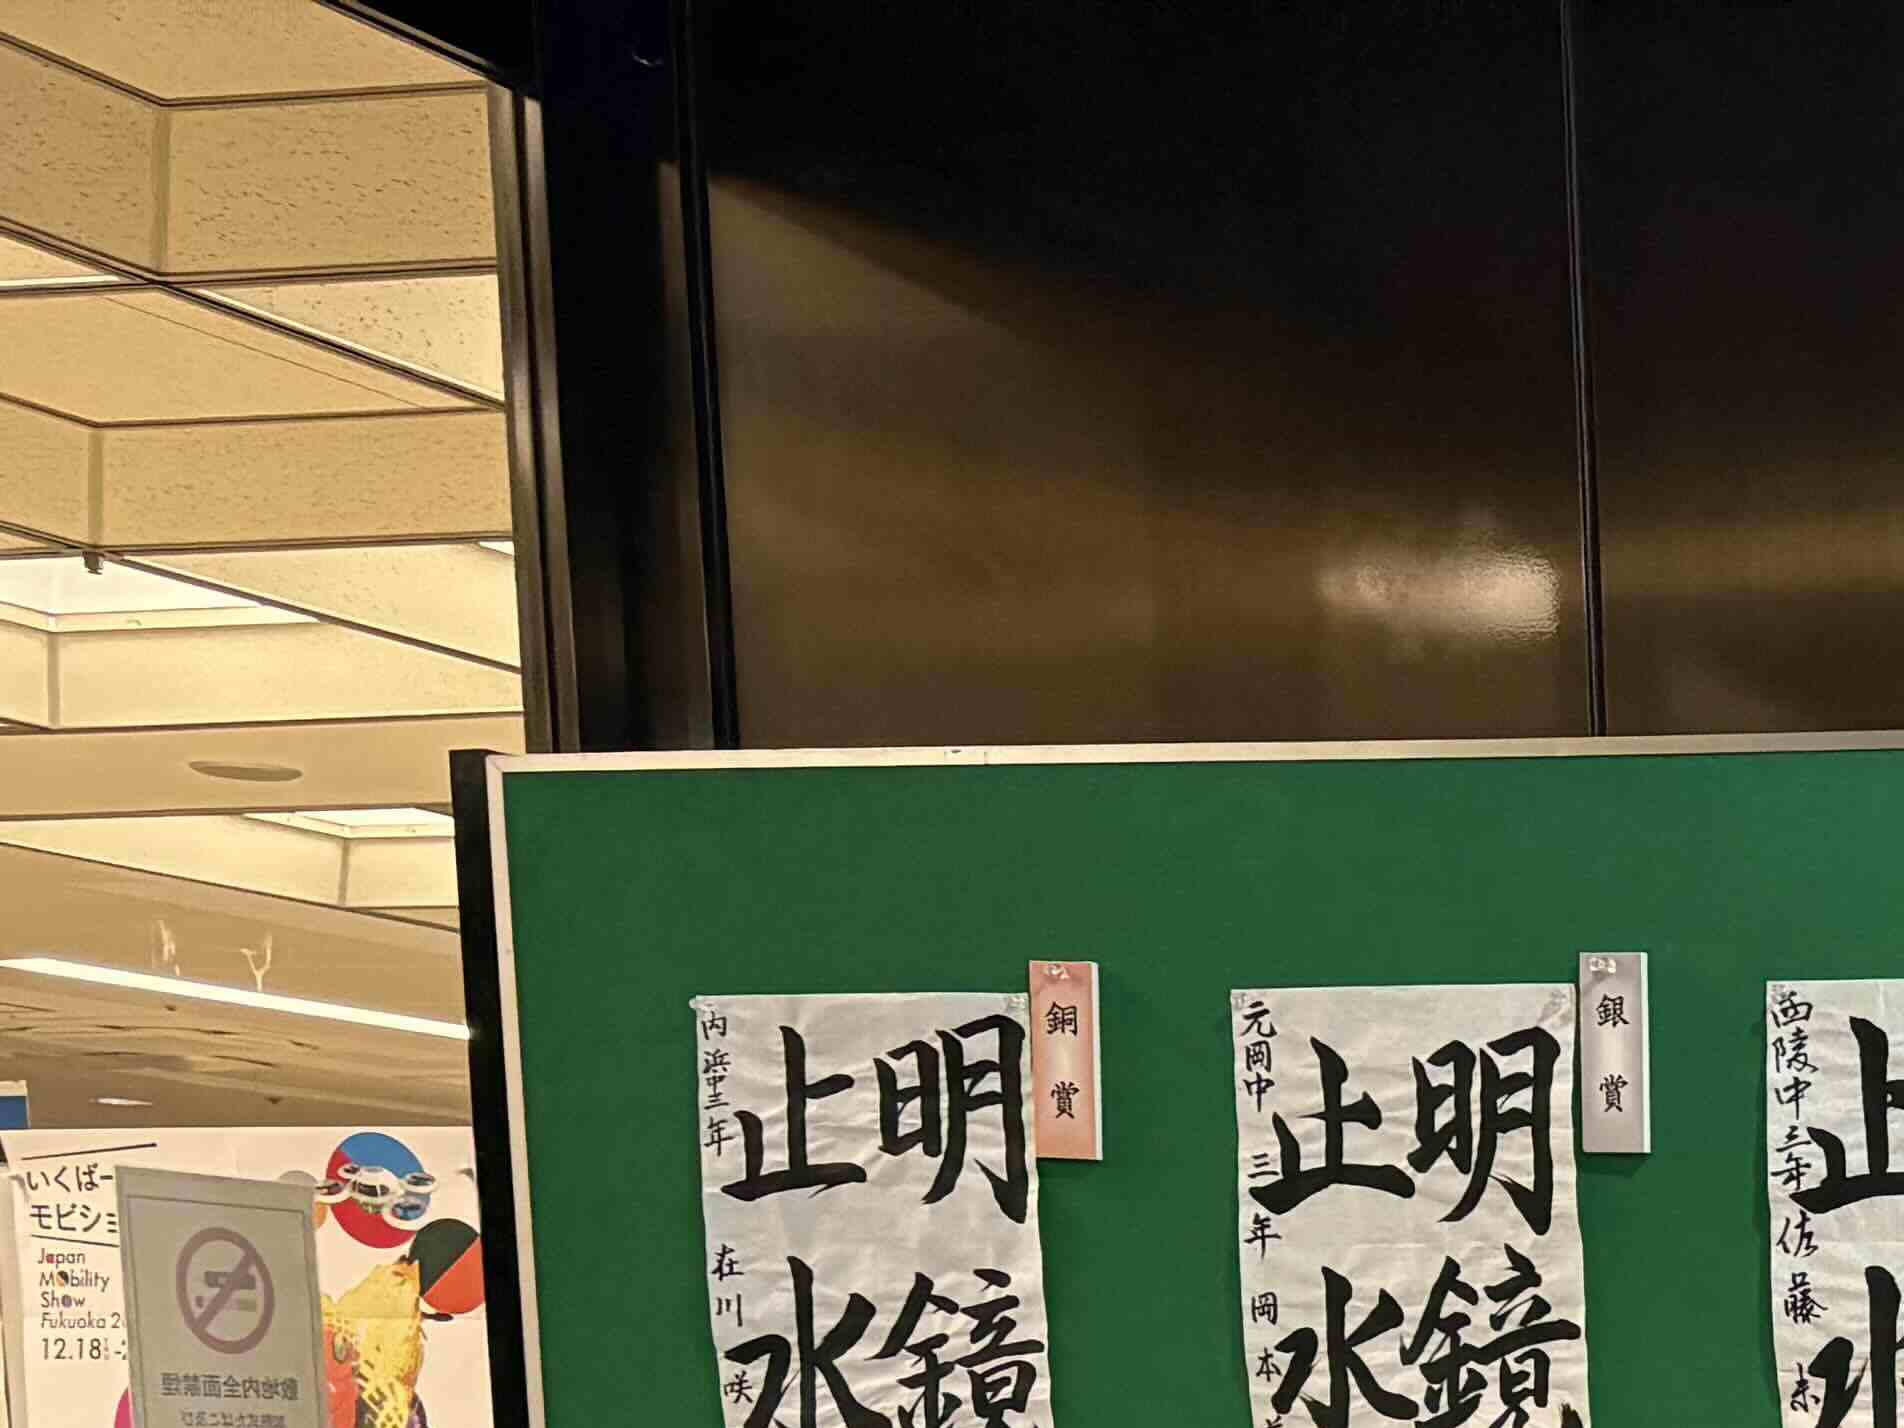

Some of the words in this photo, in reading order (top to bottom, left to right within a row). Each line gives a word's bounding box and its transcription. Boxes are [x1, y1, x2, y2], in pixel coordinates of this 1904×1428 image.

[1045, 1002, 1079, 1120] 銅賞
[1596, 995, 1630, 1113] 銀賞
[38, 1248, 85, 1268] Japan
[39, 1270, 110, 1292] Mobility
[41, 1291, 85, 1308] Show
[41, 1312, 106, 1329] Fukuoka
